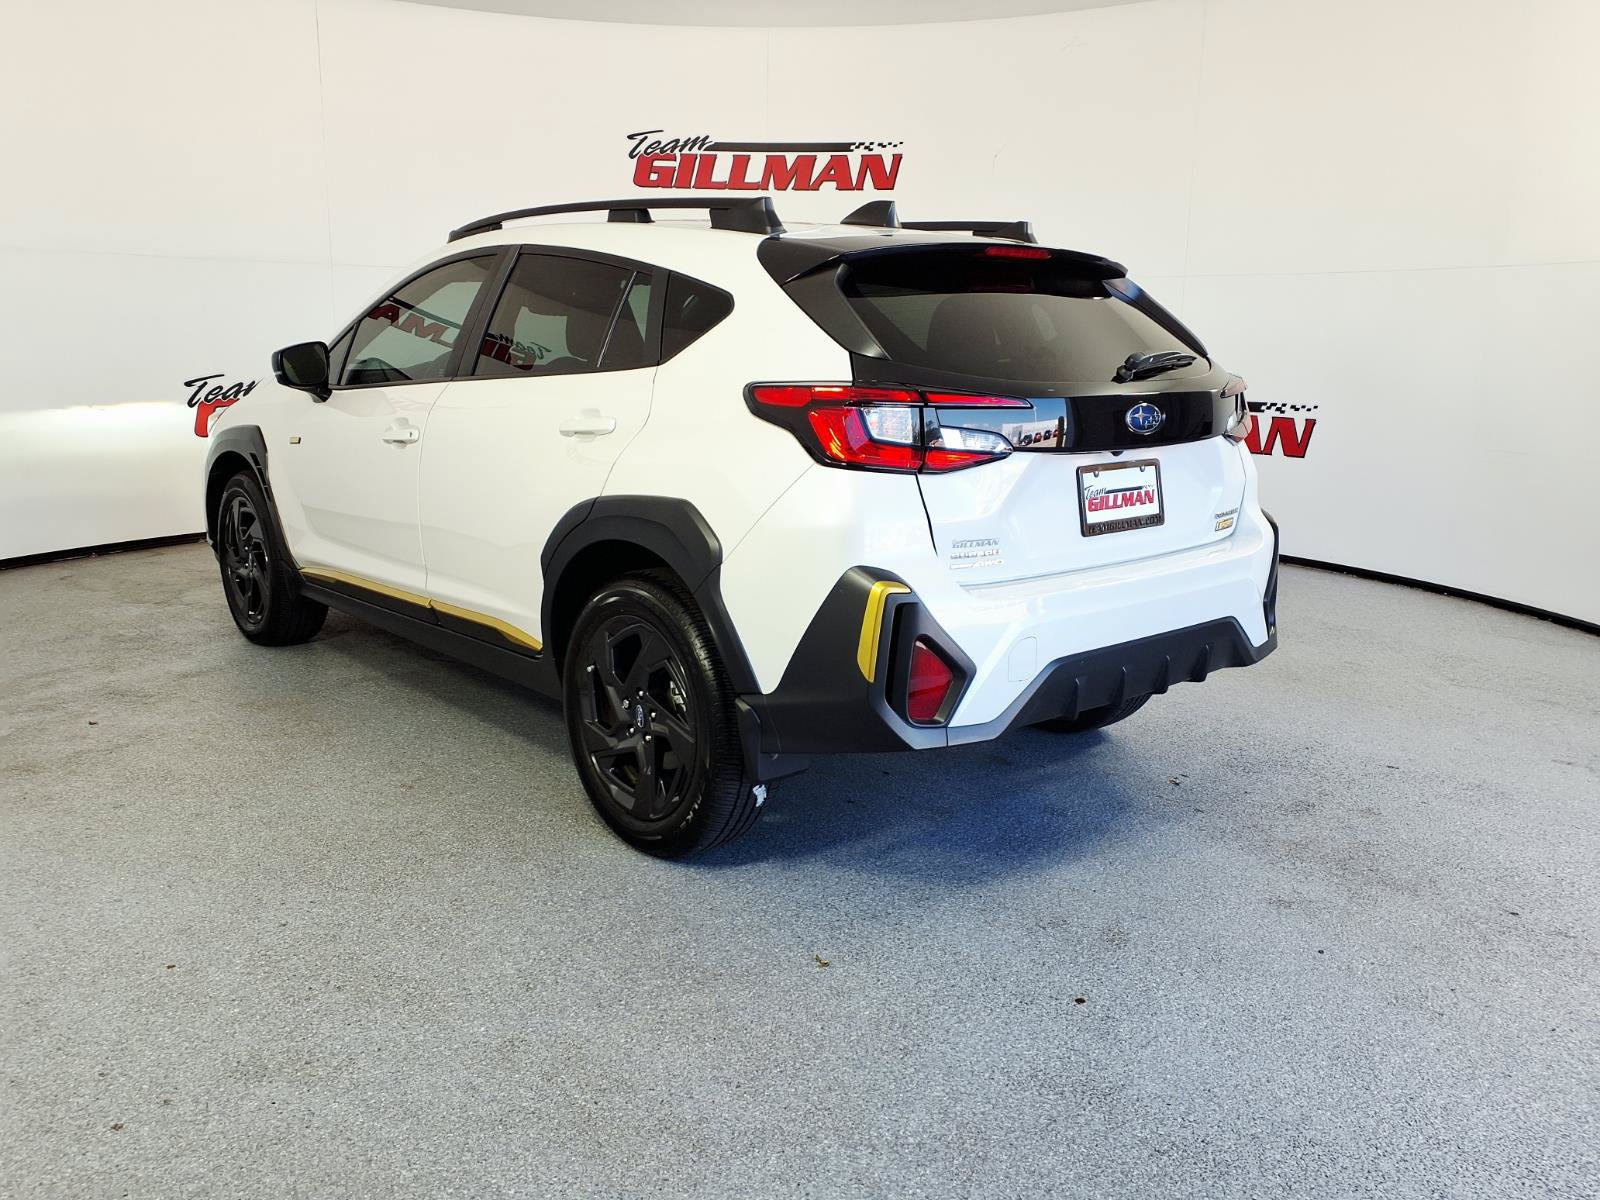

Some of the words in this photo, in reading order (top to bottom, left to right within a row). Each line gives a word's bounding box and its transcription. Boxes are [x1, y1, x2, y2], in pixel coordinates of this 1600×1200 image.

[627, 129, 712, 159] Team
[632, 153, 903, 191] GILLMAN
[1087, 489, 1155, 512] GILLMAN
